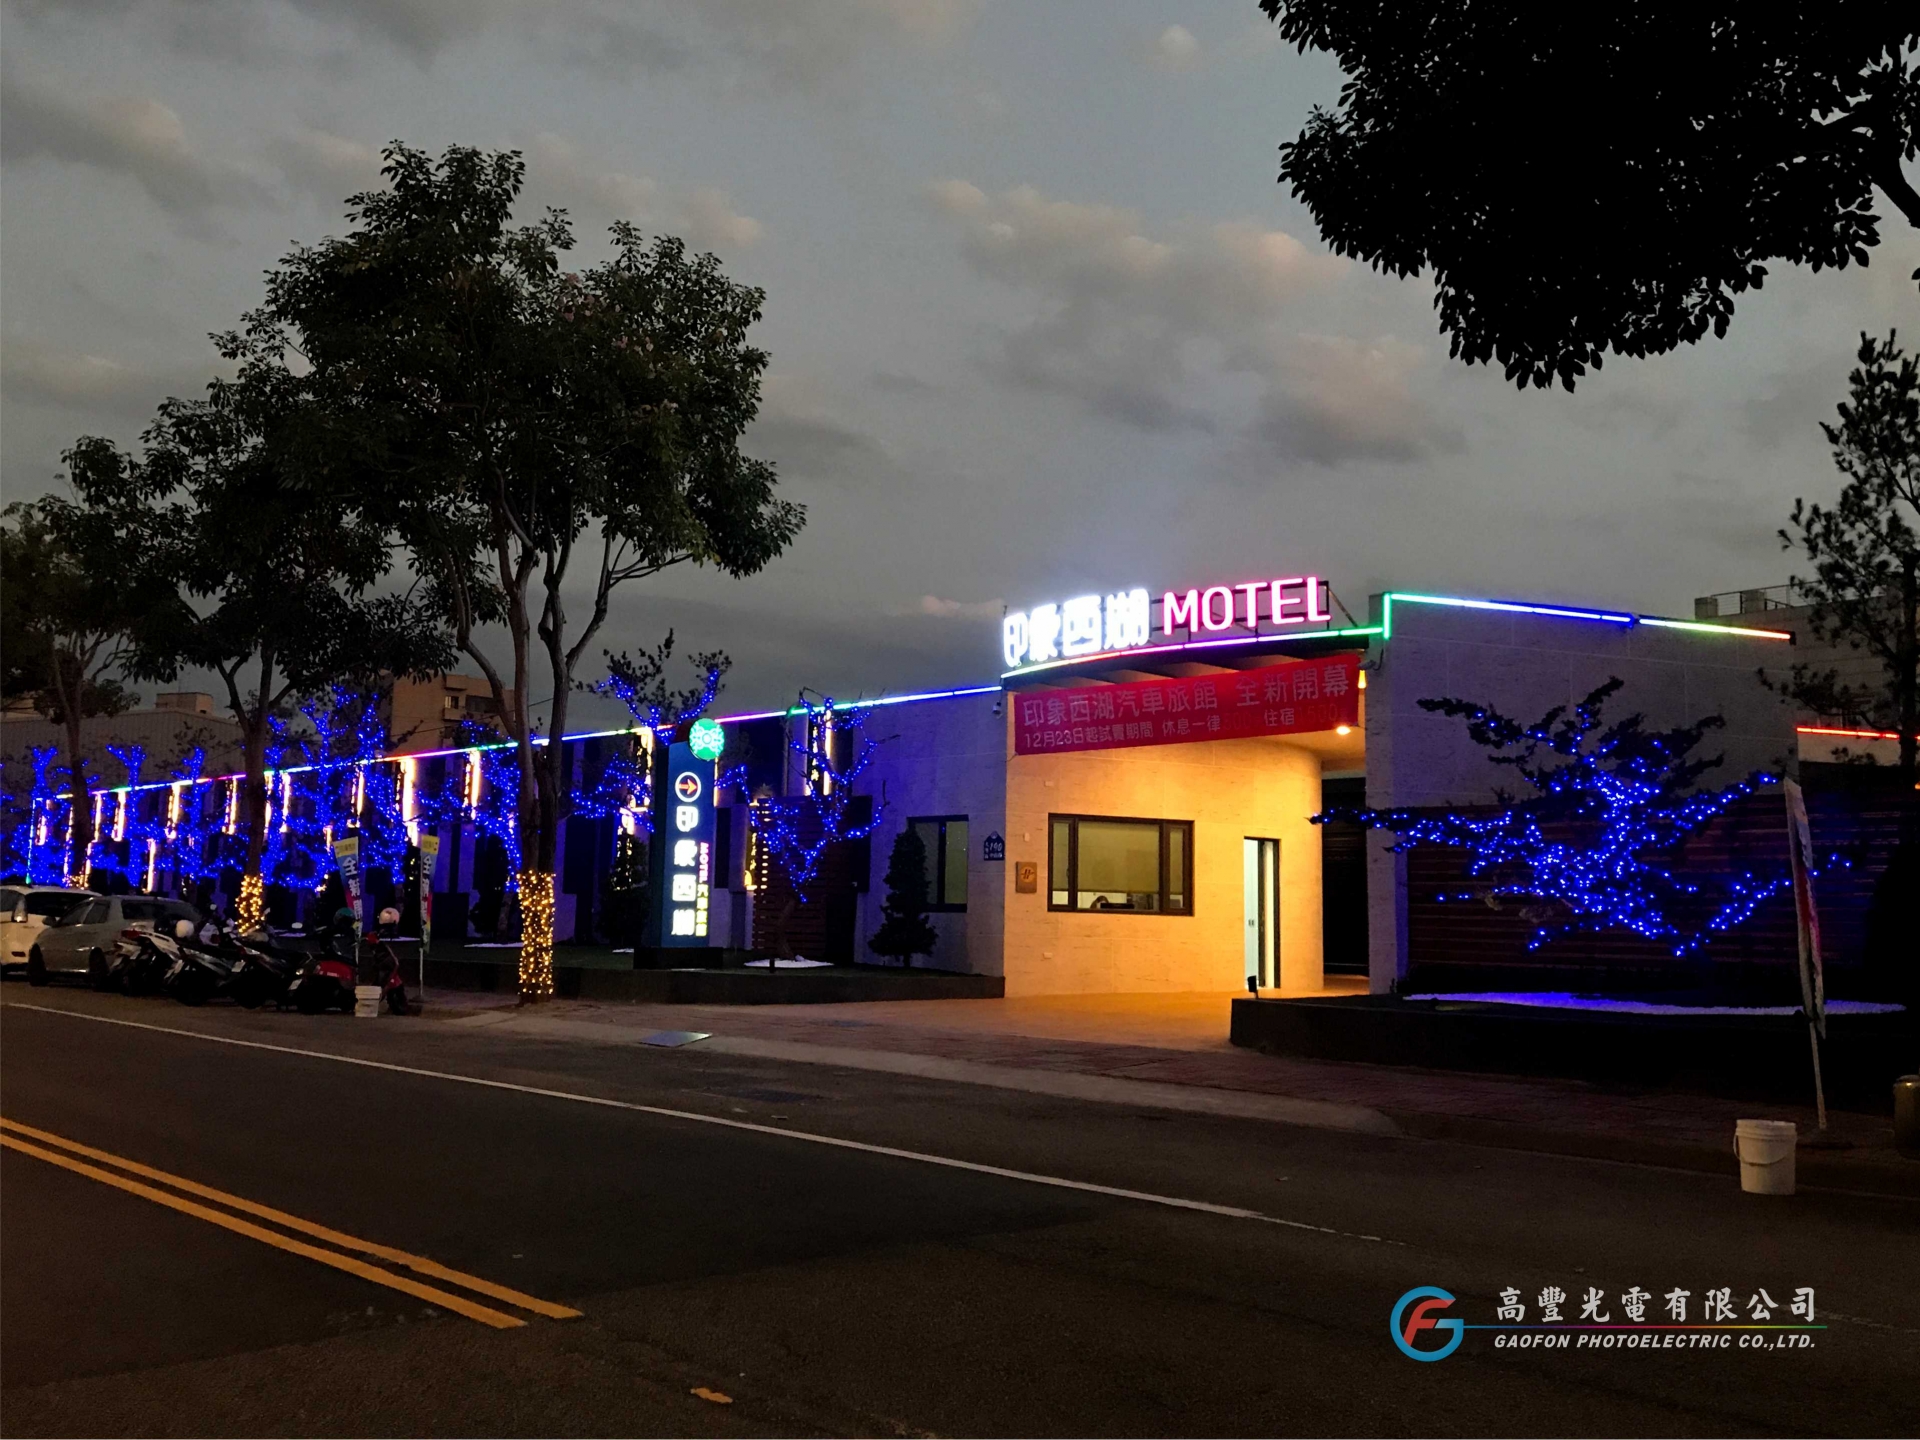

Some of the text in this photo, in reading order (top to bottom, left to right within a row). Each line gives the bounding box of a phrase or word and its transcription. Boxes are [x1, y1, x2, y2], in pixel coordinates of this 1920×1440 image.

[1163, 576, 1331, 636] MOTEL
[1023, 663, 1349, 728] 印象西湖汽車旅館 全新開幕
[699, 842, 709, 883] MOTEL
